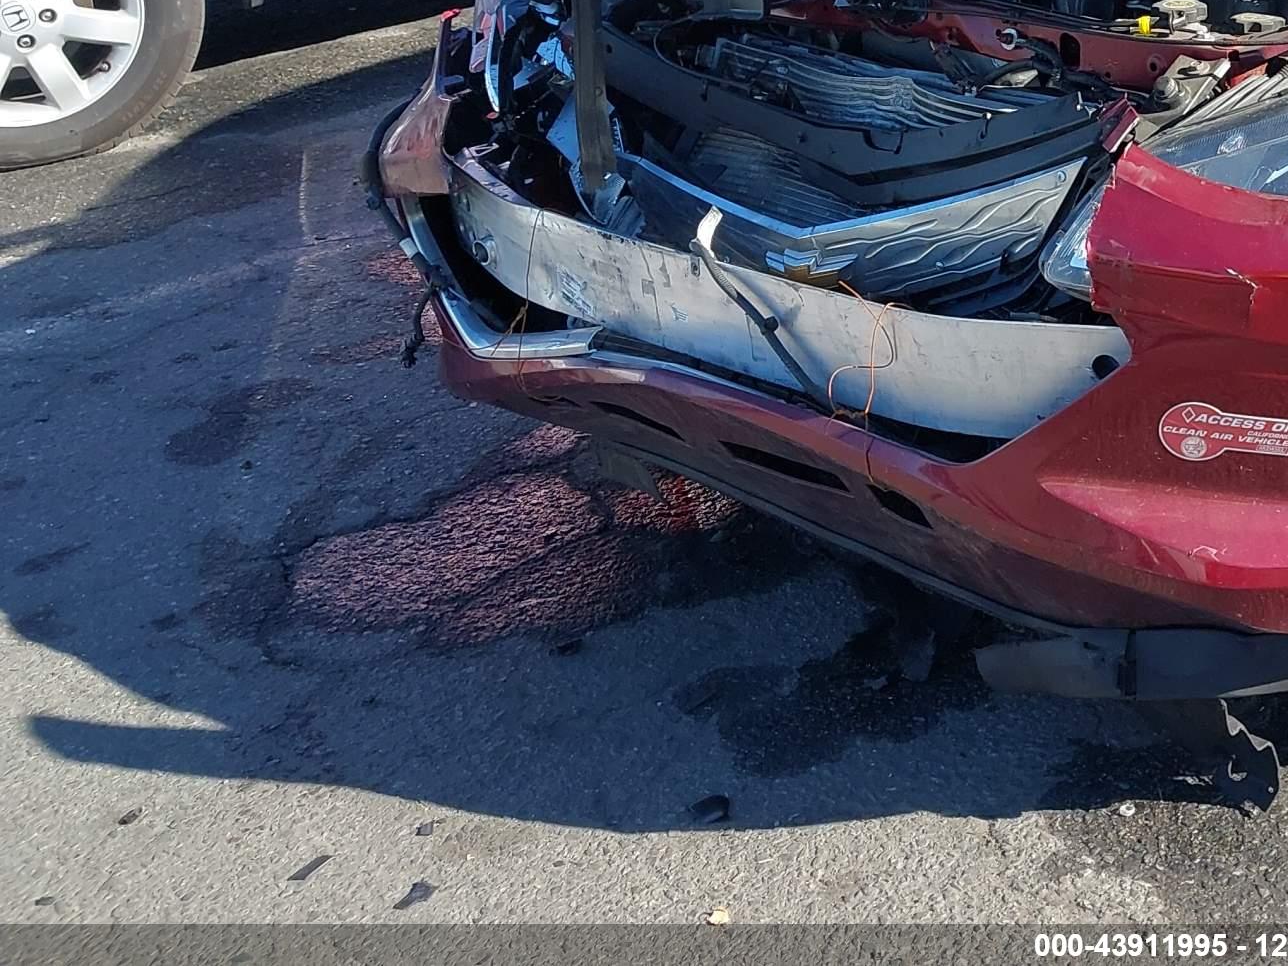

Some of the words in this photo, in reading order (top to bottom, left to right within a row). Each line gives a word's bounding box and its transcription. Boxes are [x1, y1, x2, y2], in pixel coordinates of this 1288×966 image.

[1194, 413, 1266, 430] ACCESS
[1163, 425, 1207, 437] CLEAN
[1210, 432, 1233, 441] AIR
